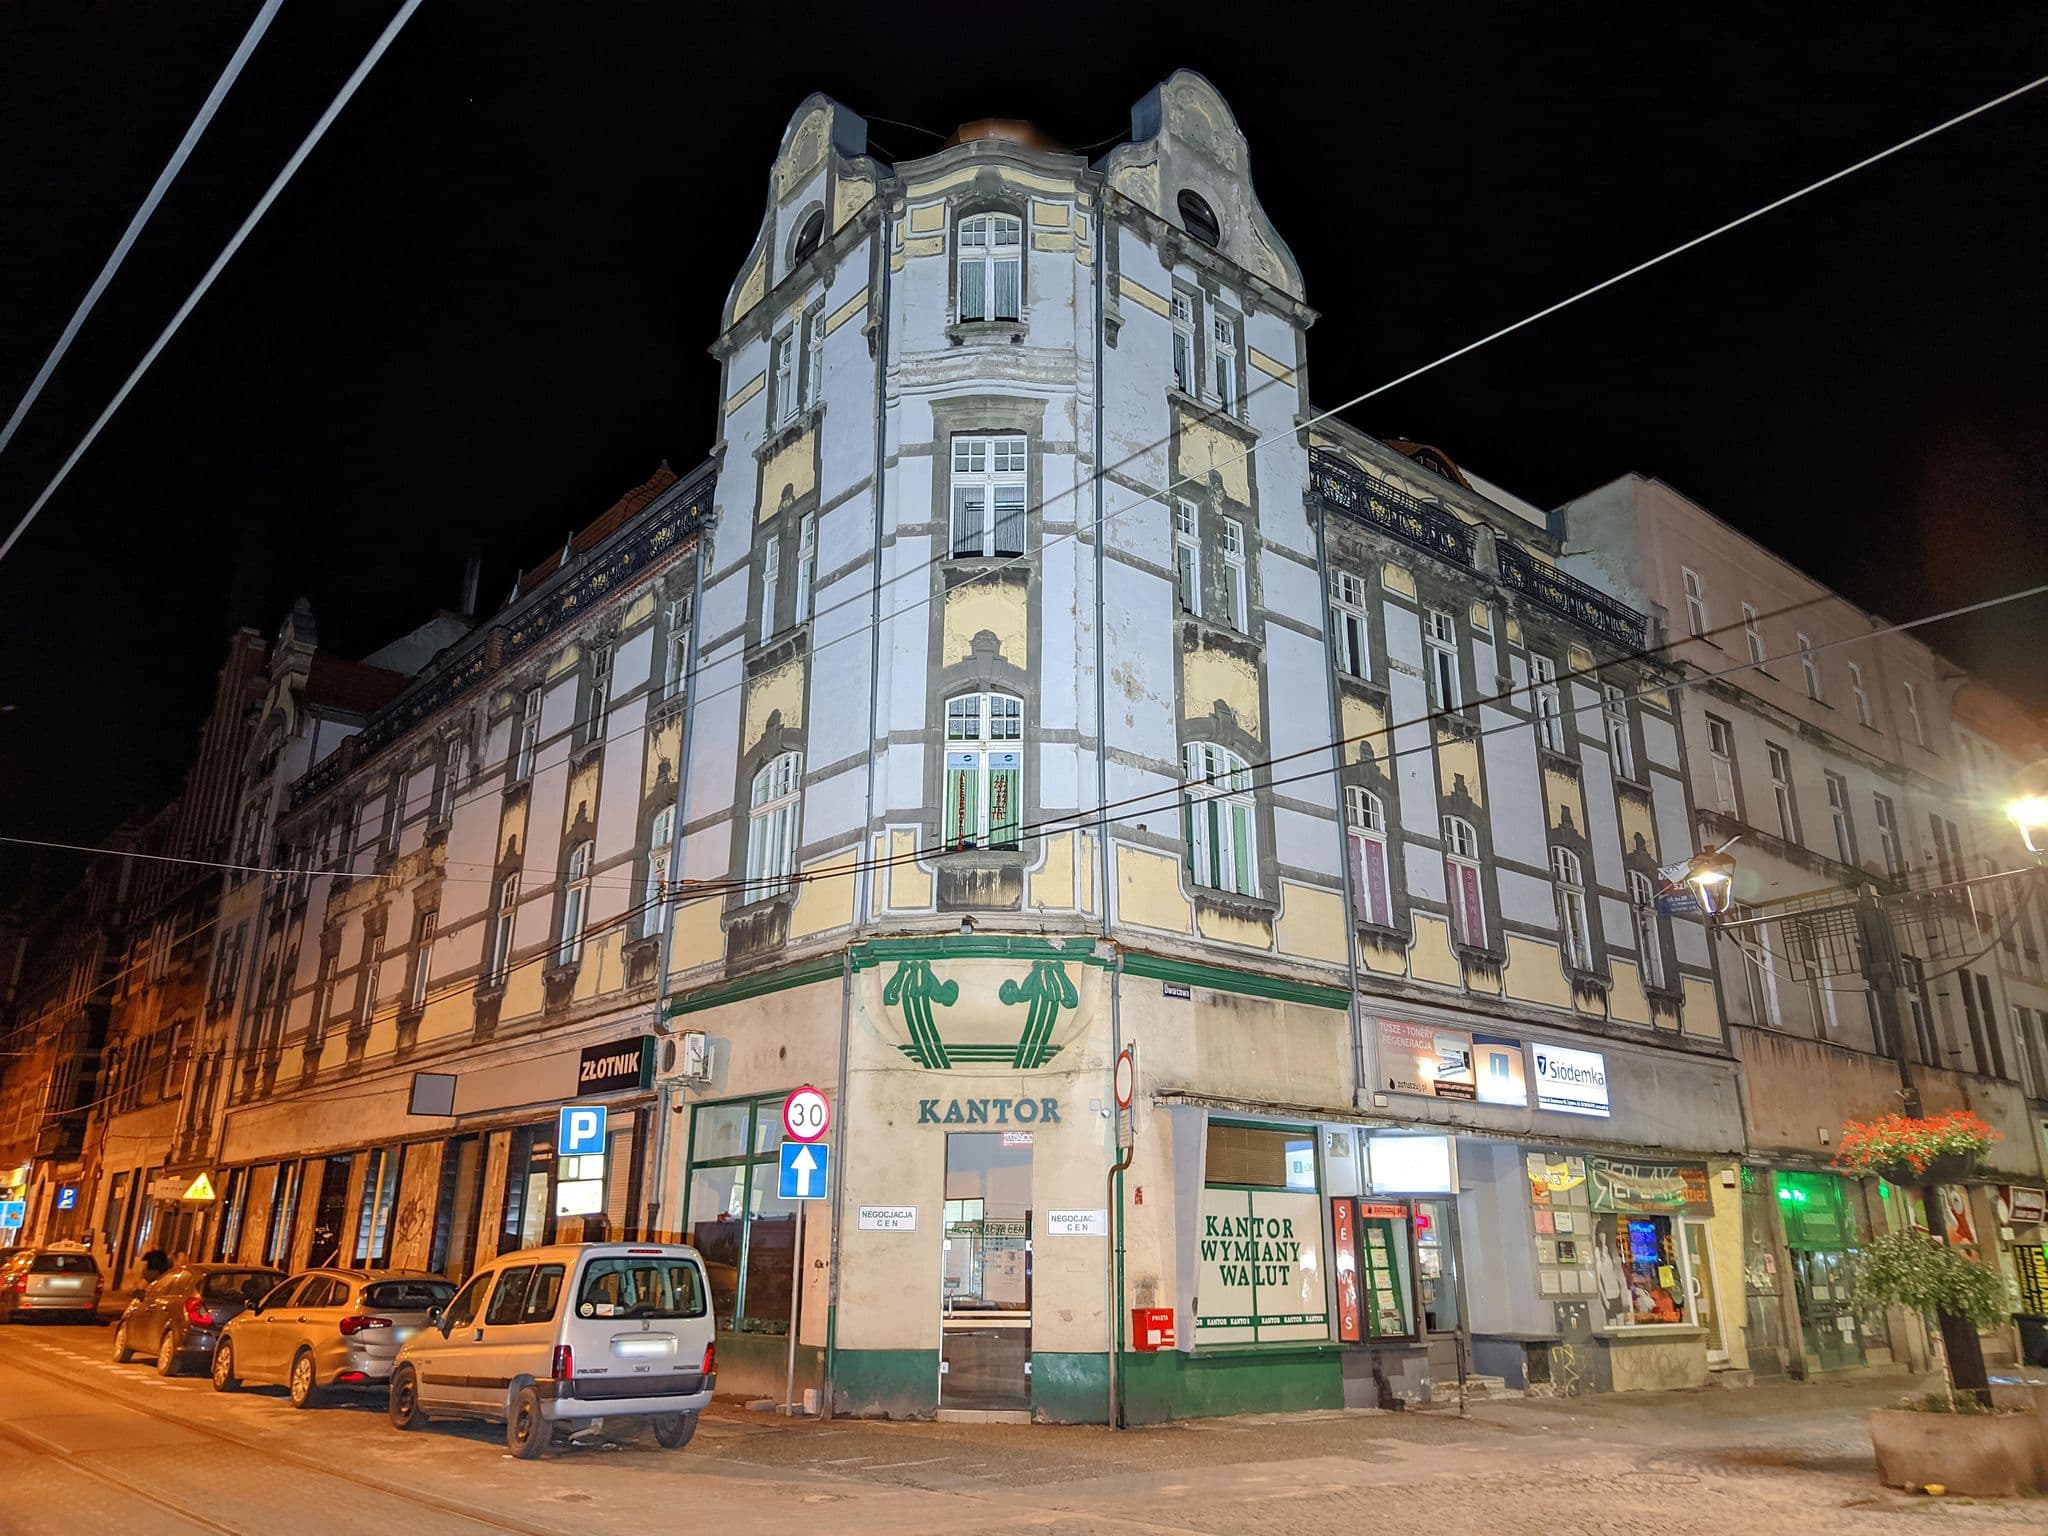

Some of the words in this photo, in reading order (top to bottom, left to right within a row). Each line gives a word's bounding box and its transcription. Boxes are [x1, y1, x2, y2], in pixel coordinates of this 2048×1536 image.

[1379, 1023, 1402, 1034] TUSZE
[1407, 1026, 1433, 1038] TONERY
[580, 1052, 641, 1082] ZŁOTNIK
[1550, 1060, 1605, 1086] Siódemka
[792, 1103, 823, 1127] 30
[917, 1098, 1062, 1124] KANTOR
[569, 1111, 598, 1150] P
[64, 1189, 74, 1199] P
[861, 1210, 913, 1219] NEGOCJACJA
[1051, 1214, 1096, 1223] NEGOCJAC
[1205, 1215, 1295, 1239] KANTOR
[1201, 1240, 1300, 1262] WYMIANY
[1219, 1264, 1290, 1287] WALUT
[1338, 1205, 1354, 1330] SEWIS
